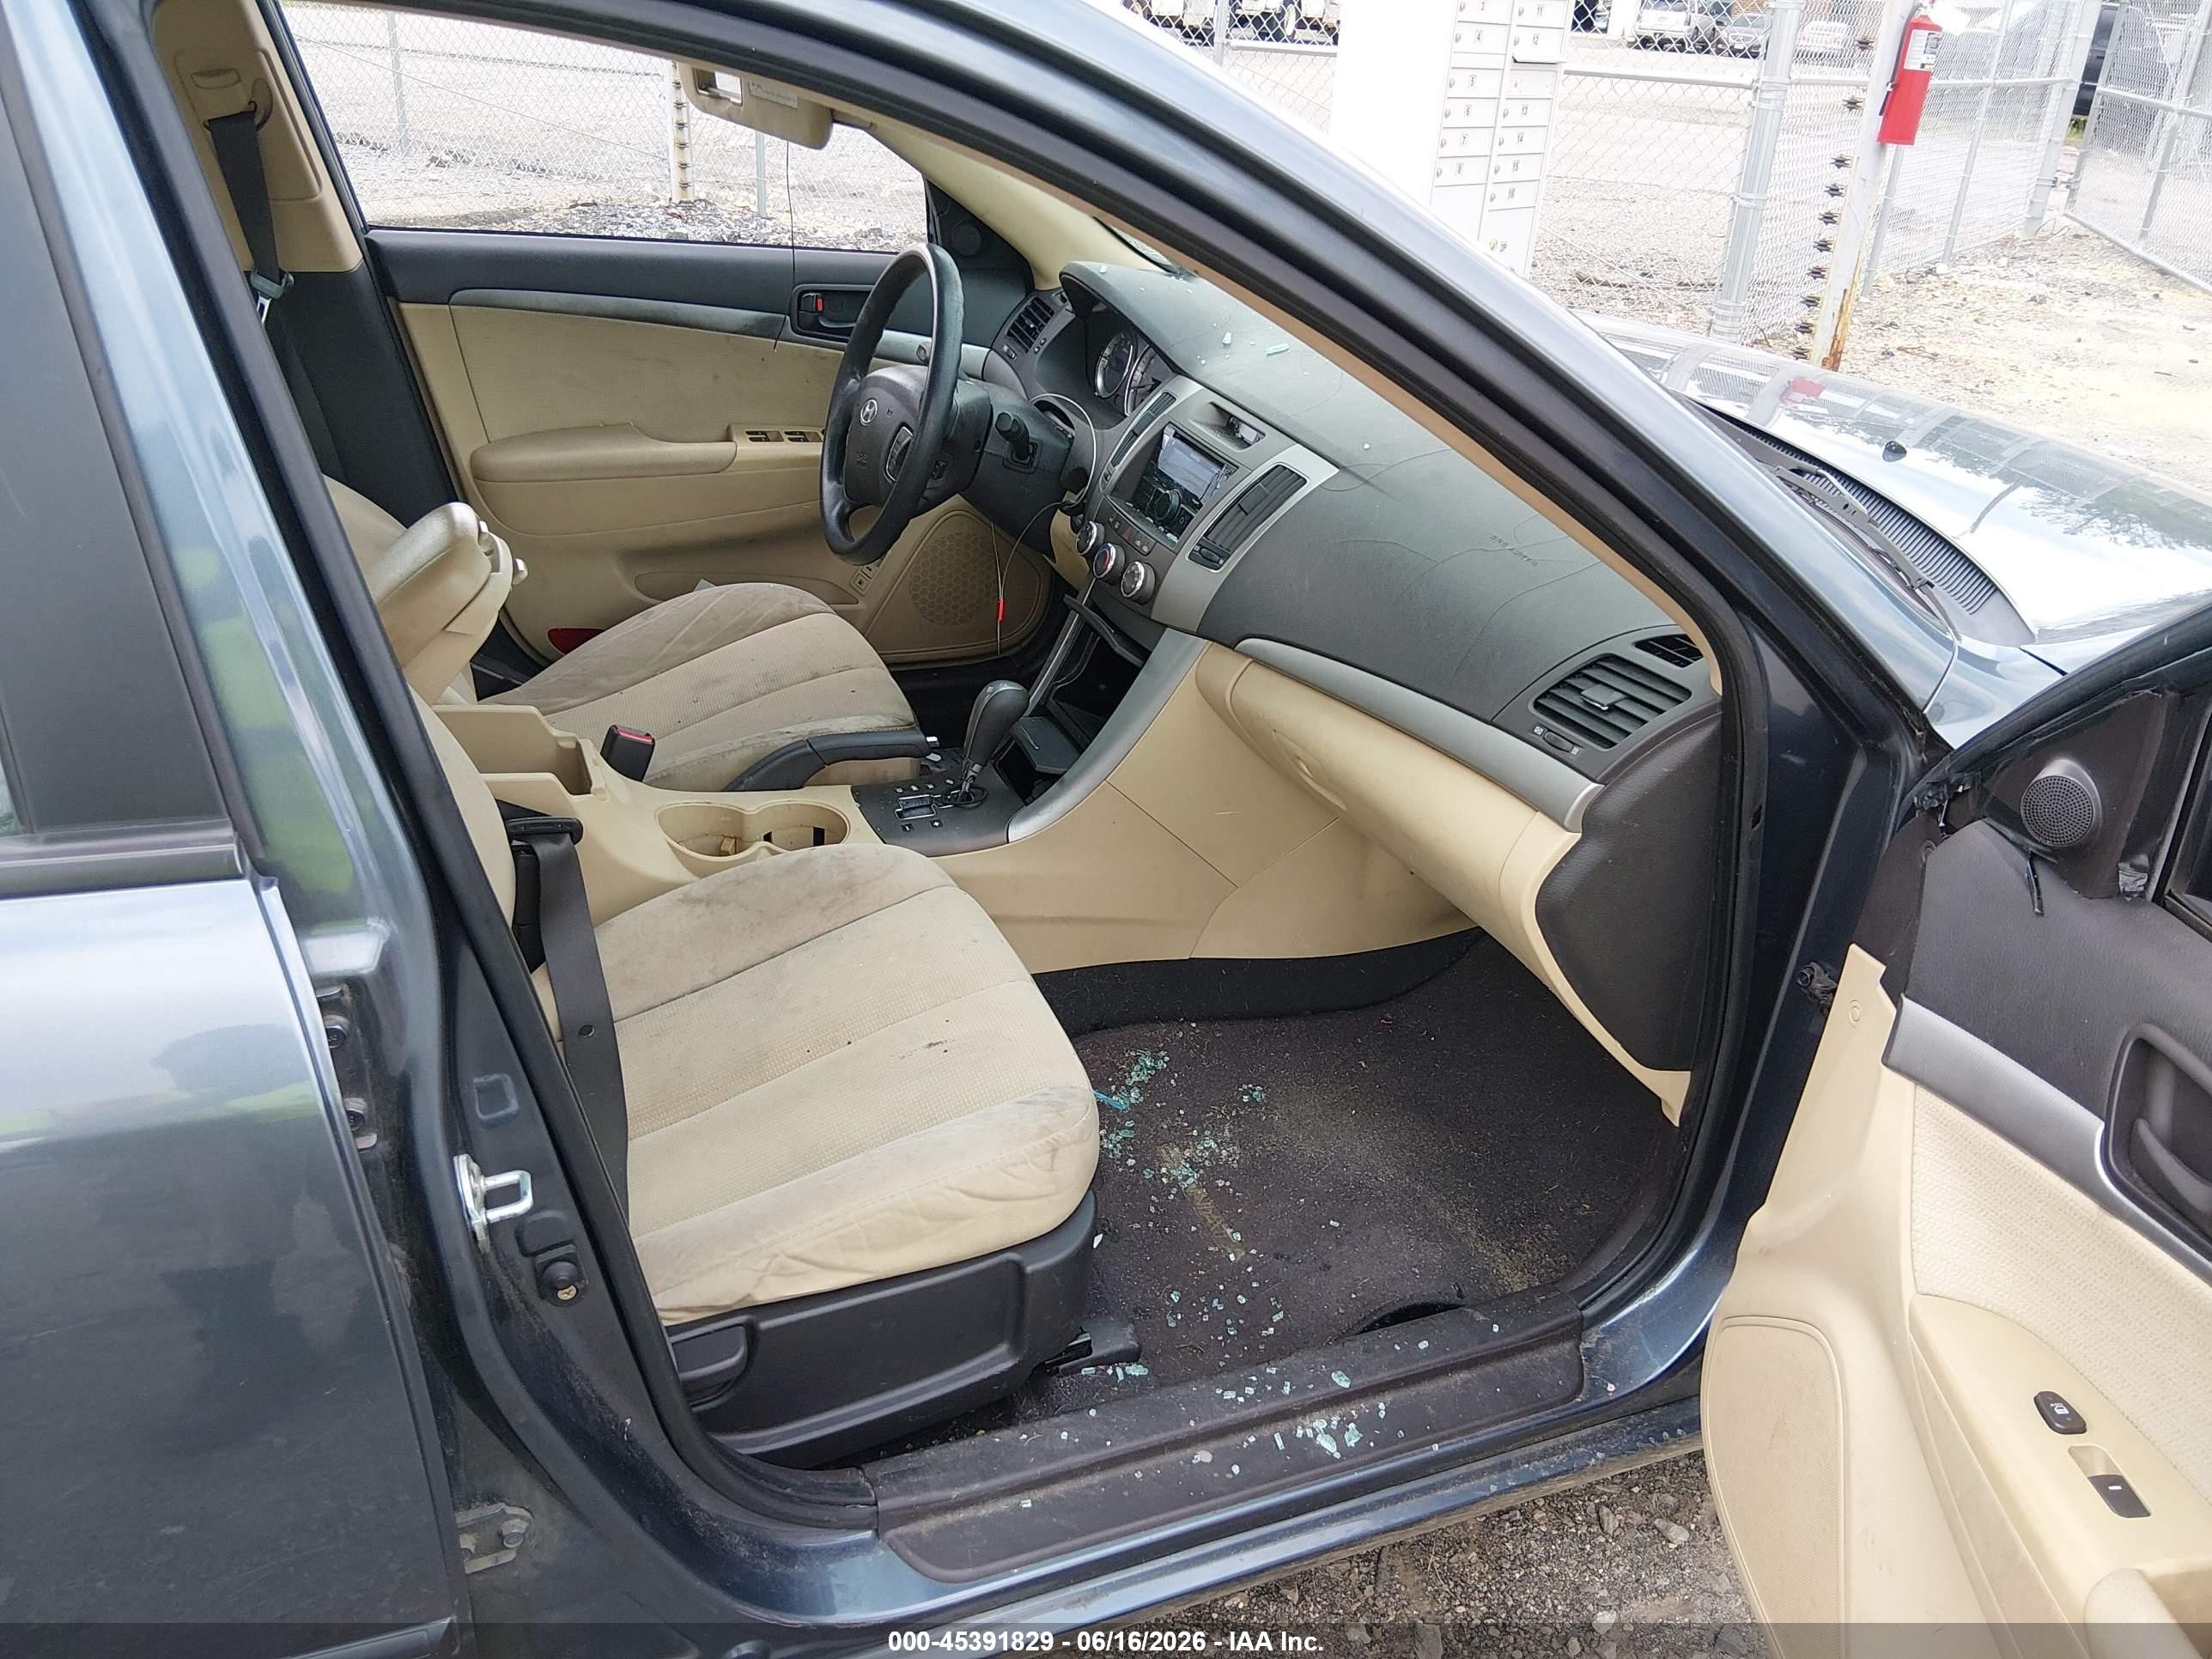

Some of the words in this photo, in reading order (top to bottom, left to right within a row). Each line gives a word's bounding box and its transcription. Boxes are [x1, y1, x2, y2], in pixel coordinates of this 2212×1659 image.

[1536, 6, 1543, 16] 11
[1533, 34, 1540, 46] 12
[1522, 106, 1528, 116] 13
[1517, 133, 1524, 143] 14
[1513, 161, 1520, 172] 15
